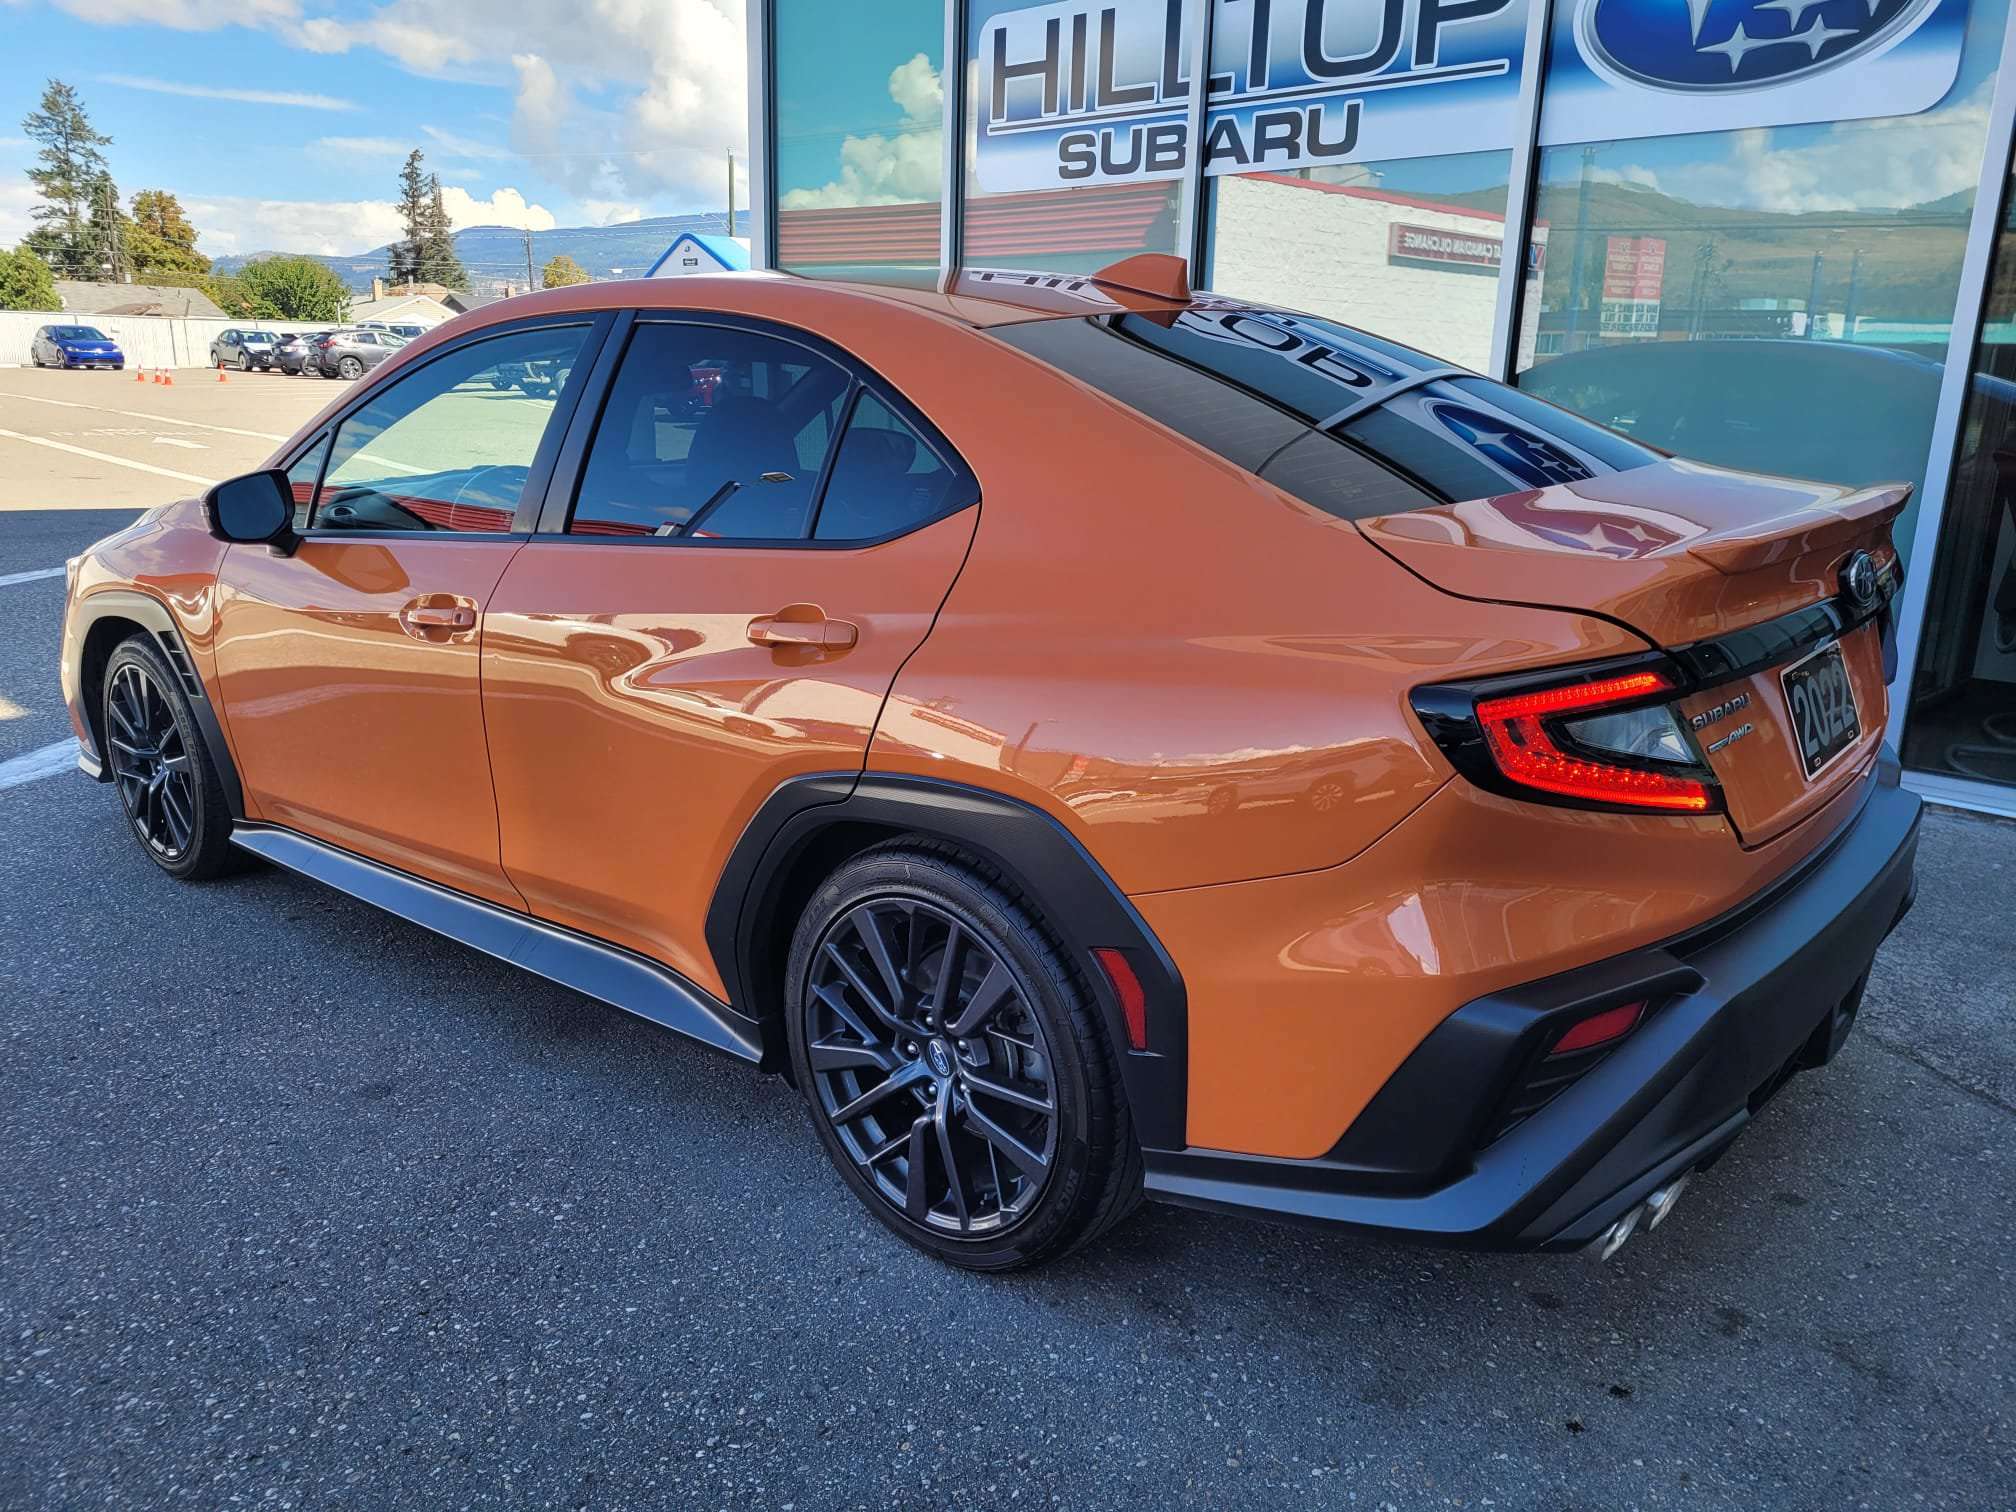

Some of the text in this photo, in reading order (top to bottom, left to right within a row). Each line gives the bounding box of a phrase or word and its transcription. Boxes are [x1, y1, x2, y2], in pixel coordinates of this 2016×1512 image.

[992, 0, 1510, 120] HILLTOP
[1058, 102, 1361, 180] SUBARU
[1692, 692, 1751, 730] SUBARU
[1793, 660, 1856, 758] 2022
